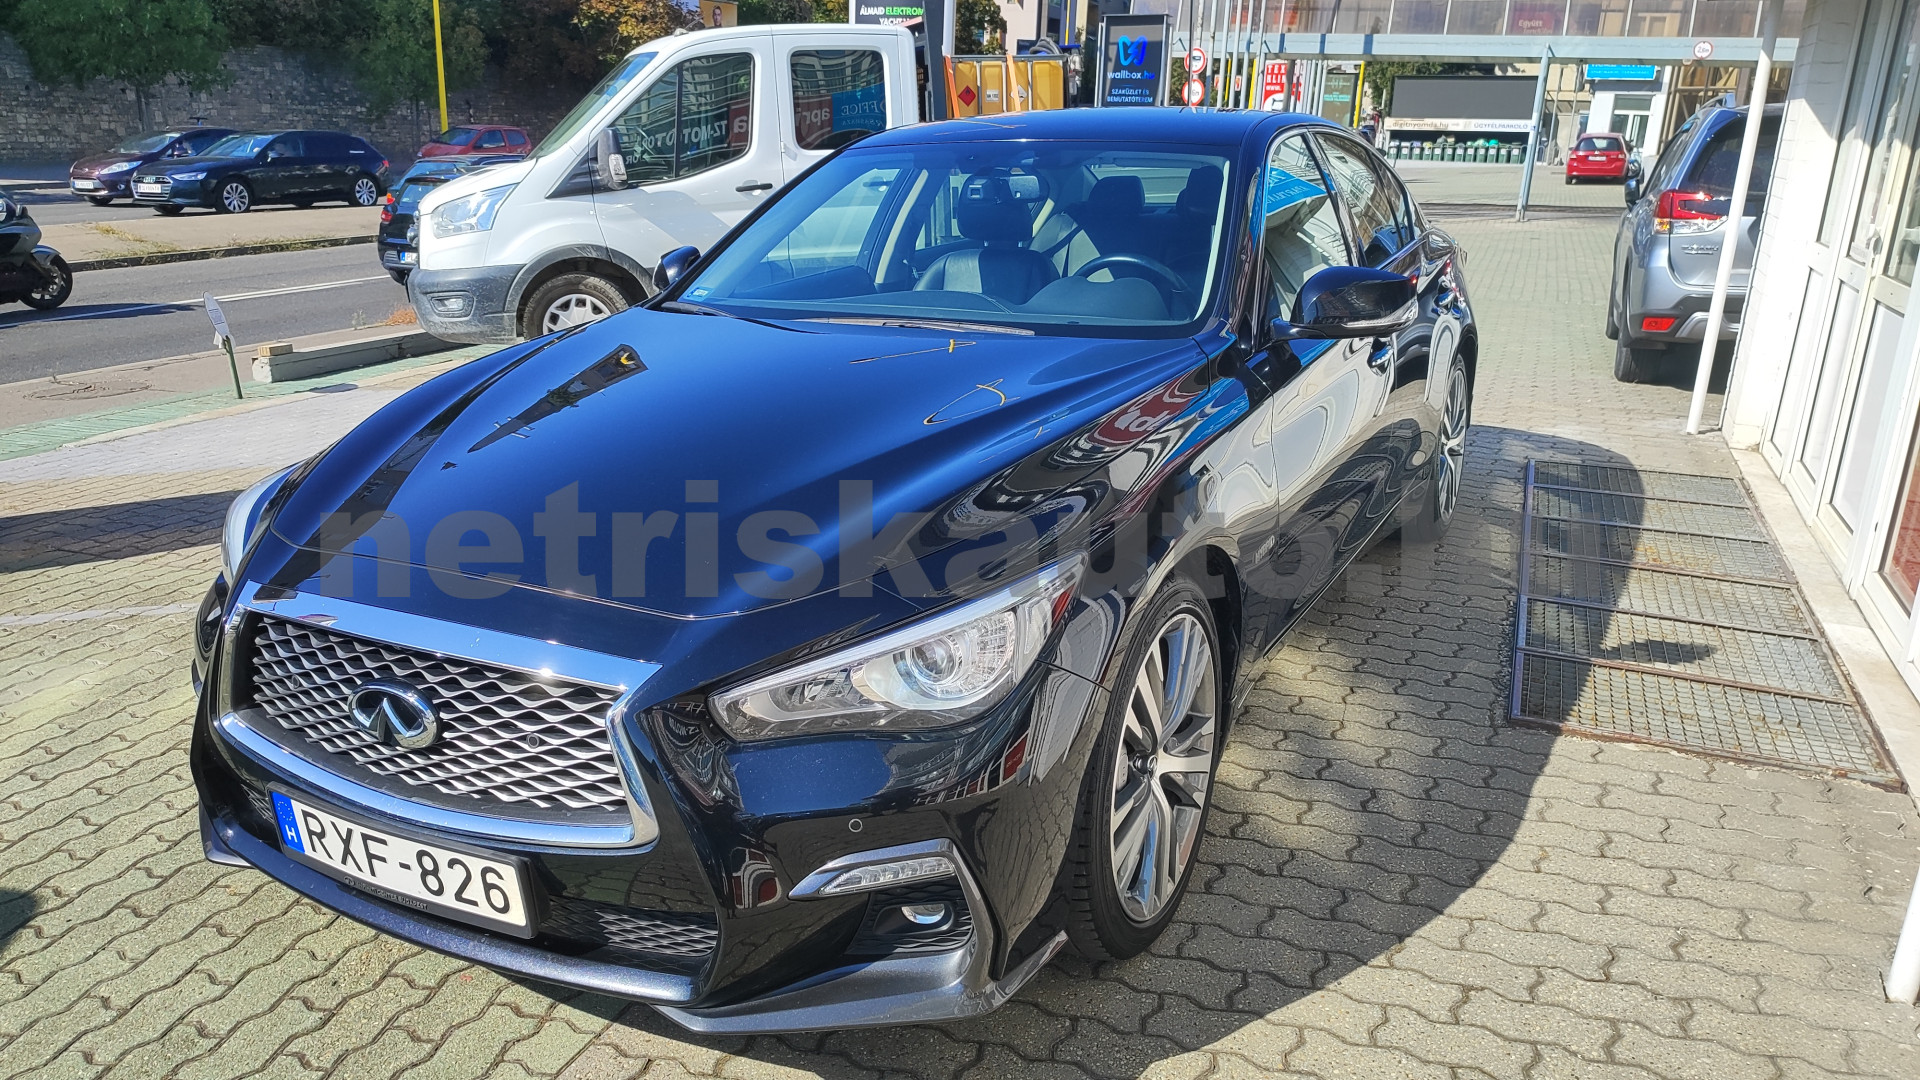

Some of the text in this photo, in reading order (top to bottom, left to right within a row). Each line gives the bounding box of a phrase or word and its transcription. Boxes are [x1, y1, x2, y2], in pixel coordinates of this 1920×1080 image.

[860, 5, 885, 16] ÁLMAID
[1107, 70, 1155, 80] wallbox.hu
[285, 808, 511, 915] H RXF-826
